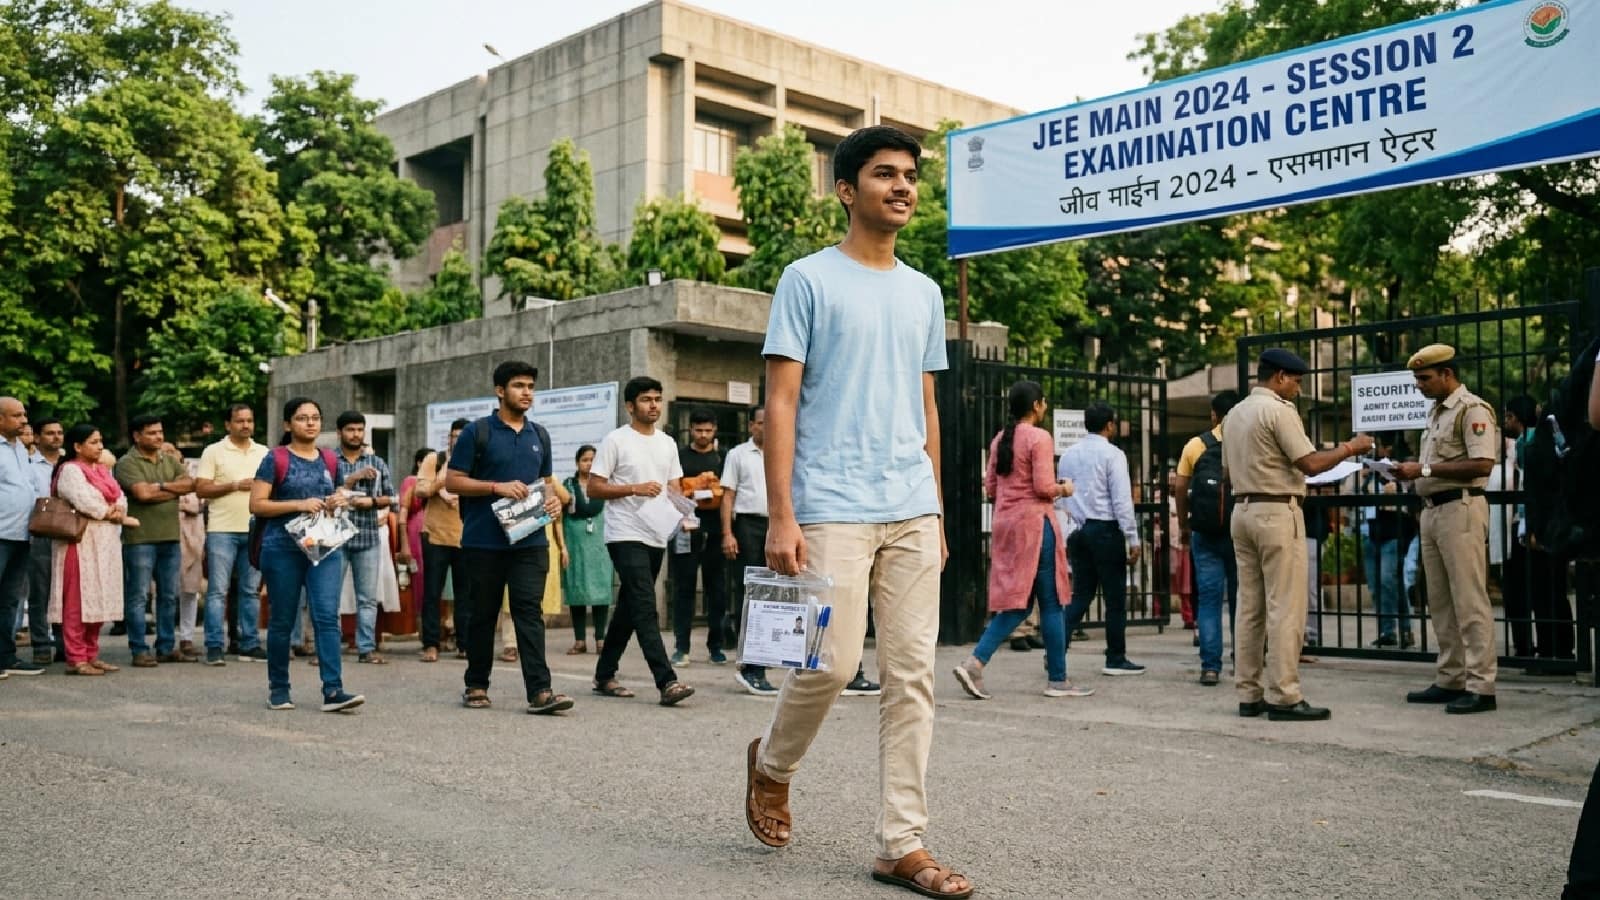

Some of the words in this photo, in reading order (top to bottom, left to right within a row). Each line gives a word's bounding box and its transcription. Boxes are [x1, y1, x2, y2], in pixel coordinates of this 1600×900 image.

[1033, 115, 1079, 150] JEE
[1089, 96, 1161, 138] MAIN
[1174, 76, 1250, 120] 2024
[1262, 84, 1275, 93] -
[1287, 32, 1437, 94] SESSION
[1452, 25, 1475, 59] 2
[1065, 110, 1271, 179] EXAMINATION
[1285, 76, 1427, 136] CENTRE
[1059, 186, 1101, 215] जीव
[1170, 164, 1236, 199] 2024
